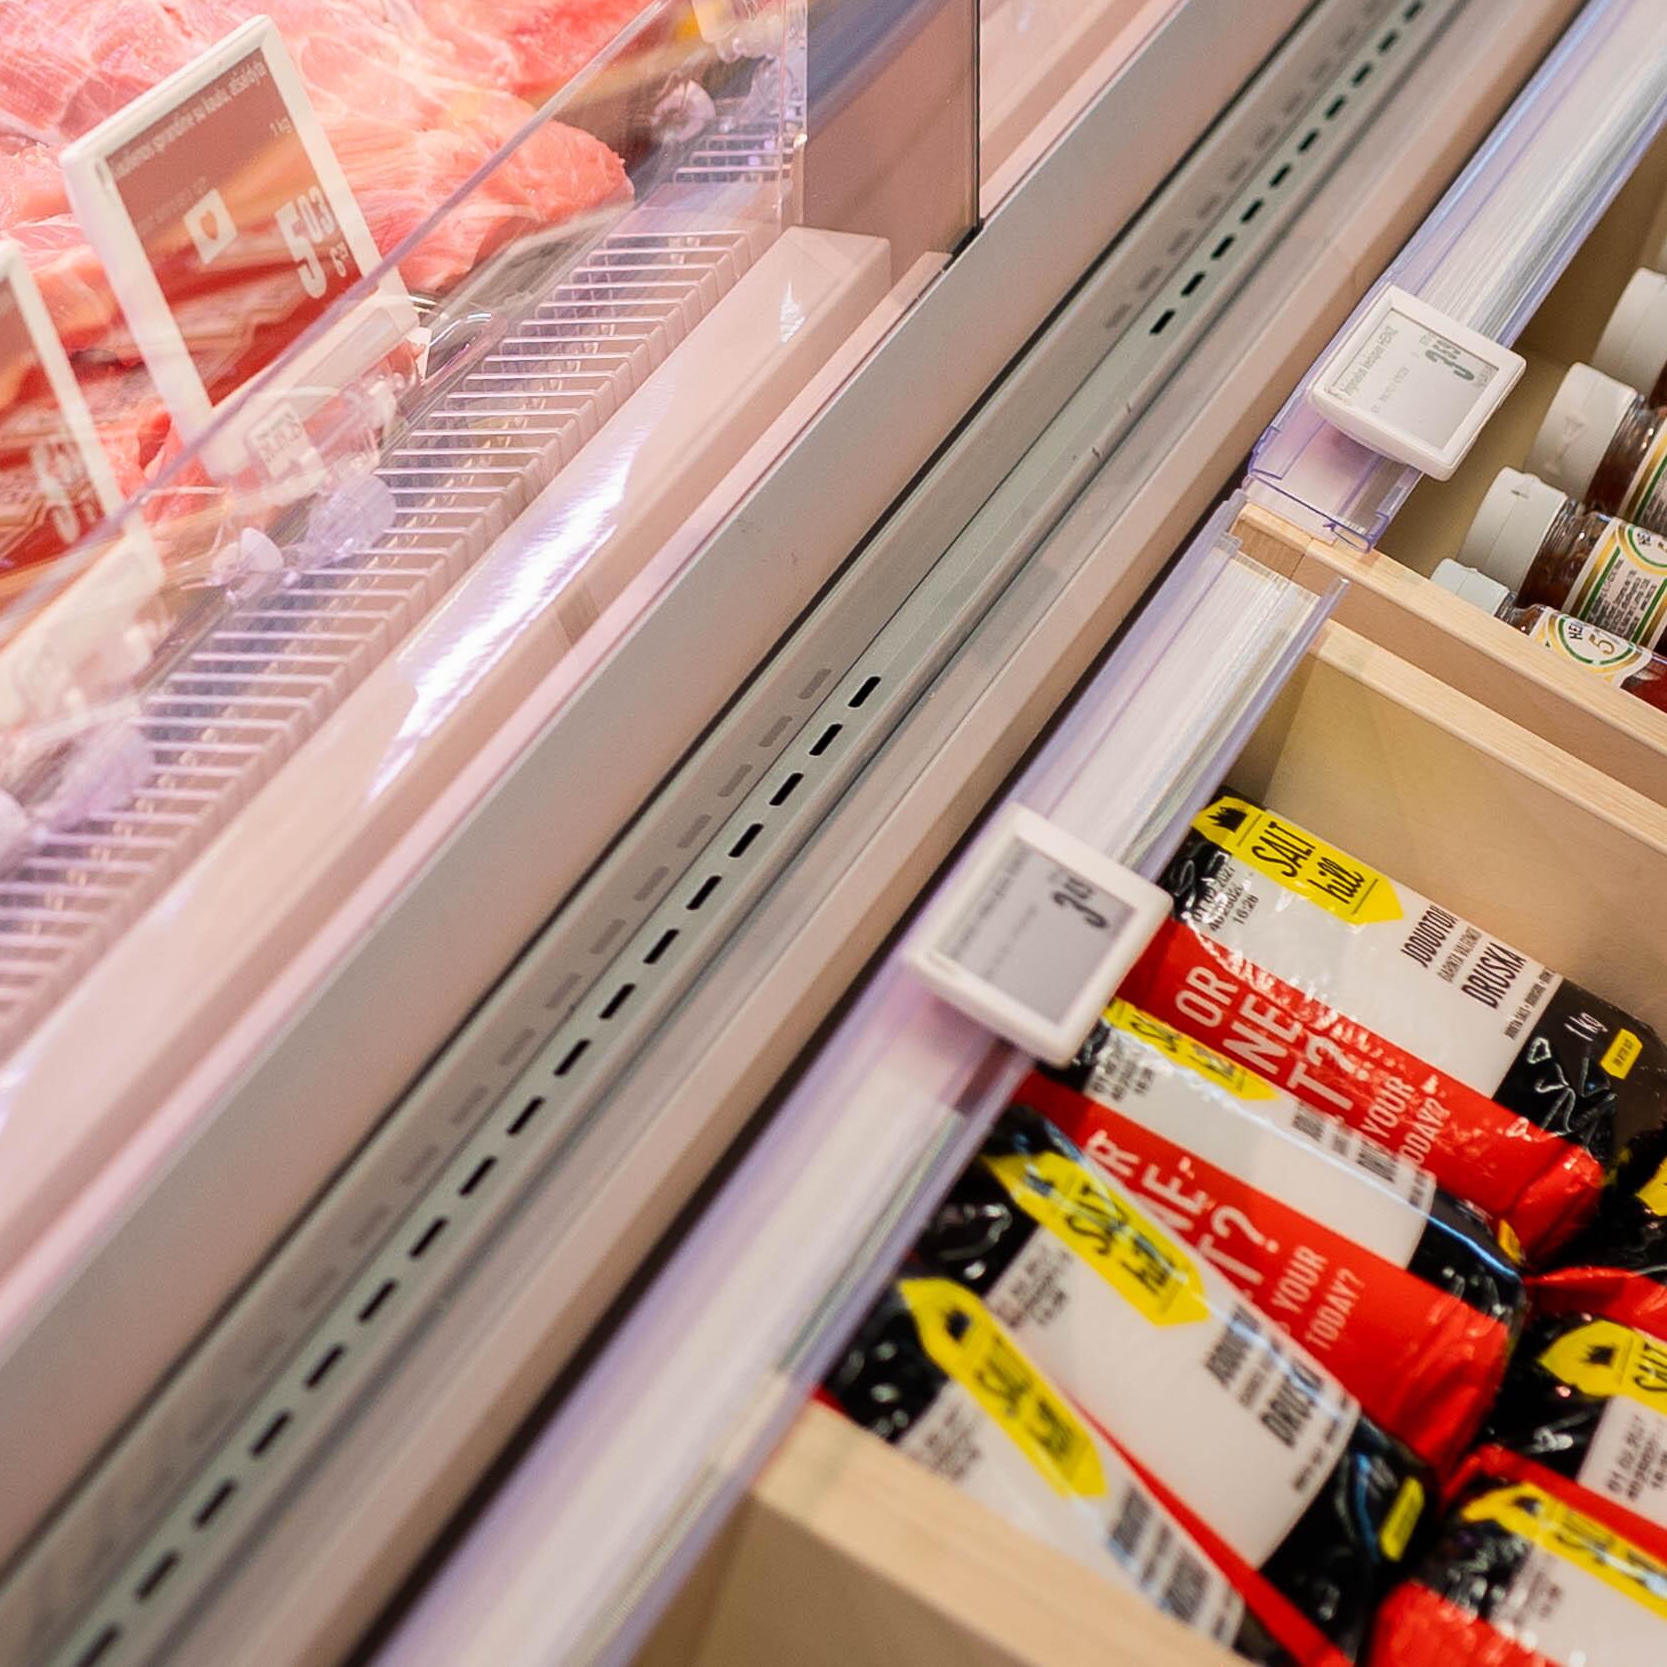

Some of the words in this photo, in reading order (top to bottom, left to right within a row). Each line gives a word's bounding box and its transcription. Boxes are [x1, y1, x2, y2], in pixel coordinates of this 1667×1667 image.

[1252, 821, 1317, 878] SALT
[1307, 854, 1366, 905] hill
[1461, 941, 1527, 1009] DRUSKA
[1564, 1023, 1594, 1041] 1
[1568, 1012, 1608, 1034] kg
[1286, 1036, 1370, 1111] T?
[1361, 1076, 1415, 1139] YOUR
[1398, 1096, 1451, 1165] ODAY?
[1084, 1129, 1141, 1177] R
[1269, 1245, 1329, 1314] YOUR
[1304, 1267, 1366, 1351] TODAY?
